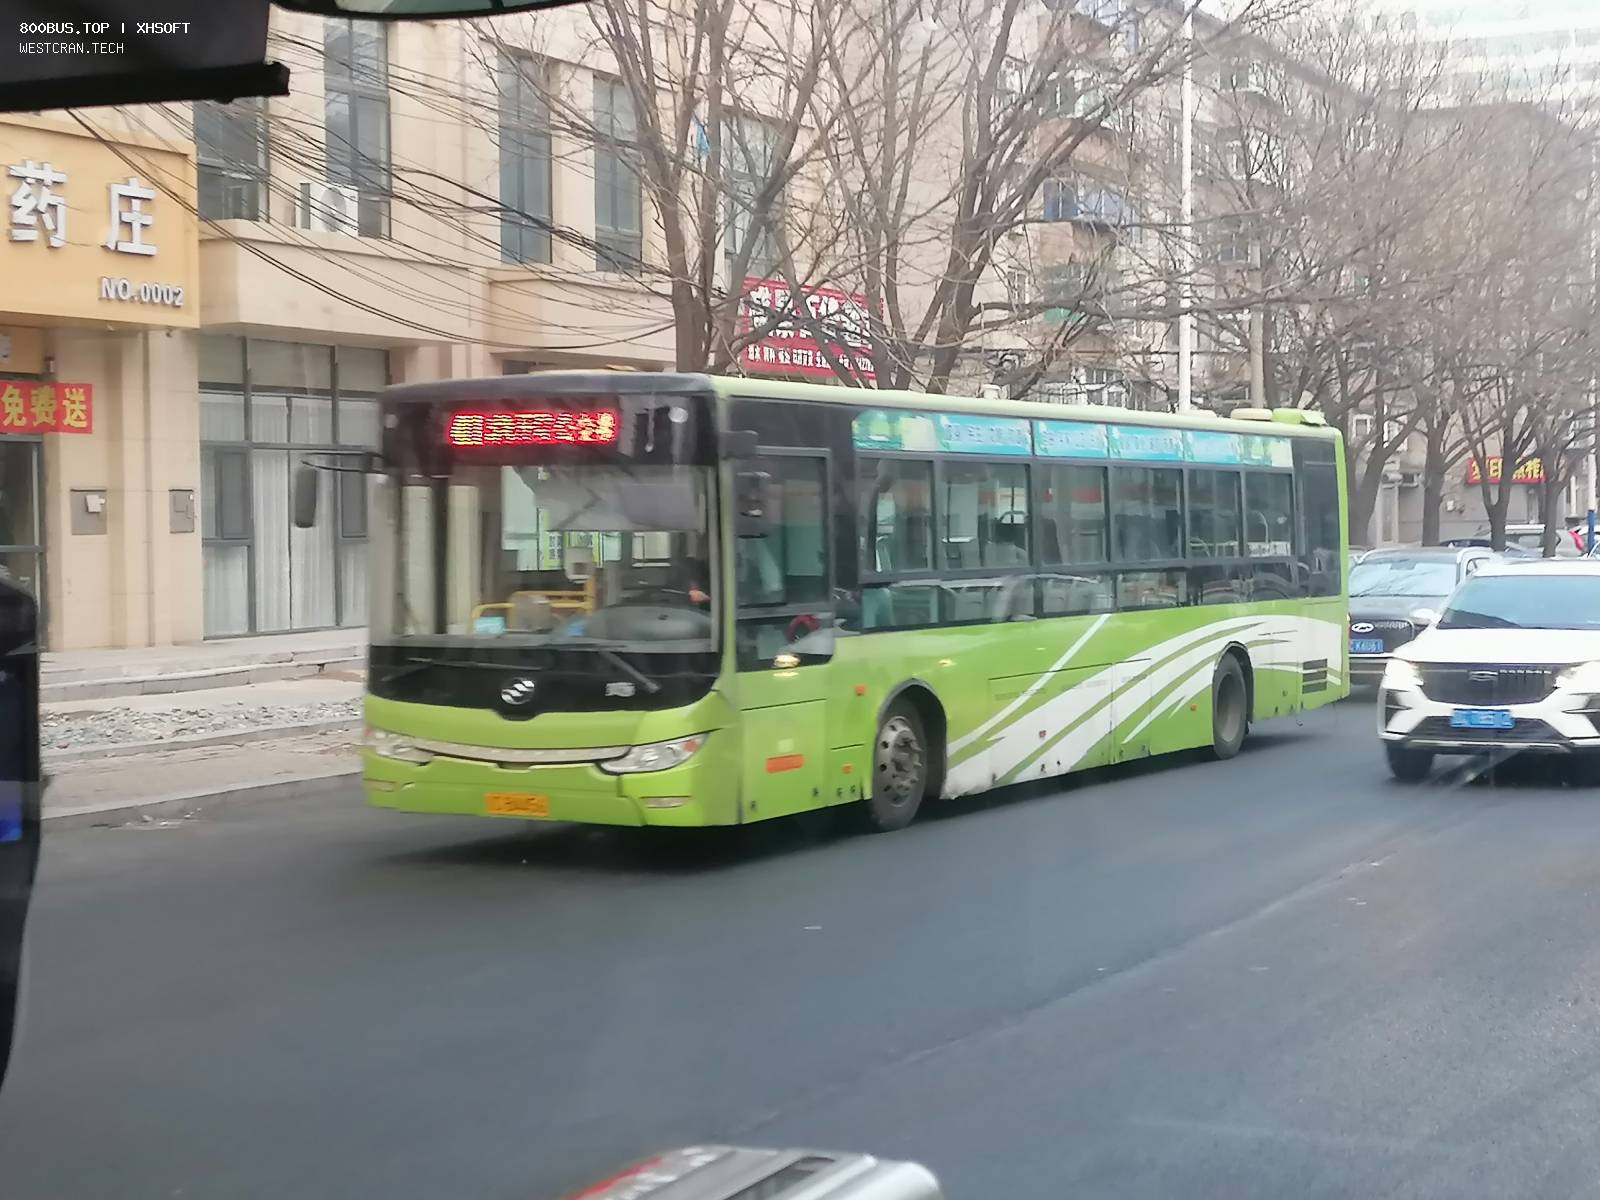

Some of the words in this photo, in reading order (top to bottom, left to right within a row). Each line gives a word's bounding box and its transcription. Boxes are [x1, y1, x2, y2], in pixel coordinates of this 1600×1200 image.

[8, 160, 158, 256] 药庄
[100, 277, 185, 308] NO.0002
[1, 384, 88, 428] 免费送
